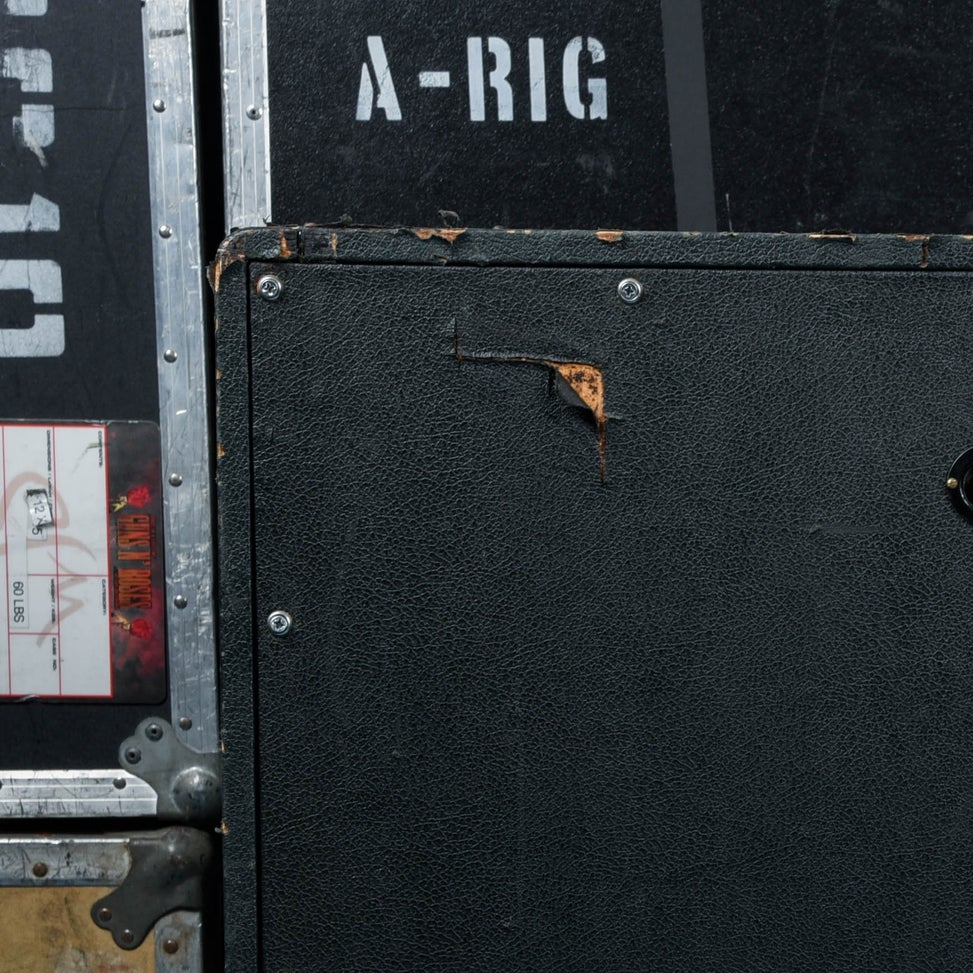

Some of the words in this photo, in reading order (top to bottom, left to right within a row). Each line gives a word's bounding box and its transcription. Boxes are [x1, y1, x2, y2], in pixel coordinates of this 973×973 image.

[355, 35, 608, 122] A-RIG
[117, 514, 151, 547] GUNS
[13, 581, 25, 596] 60
[117, 569, 152, 609] ROSES
[13, 599, 25, 623] LBS
